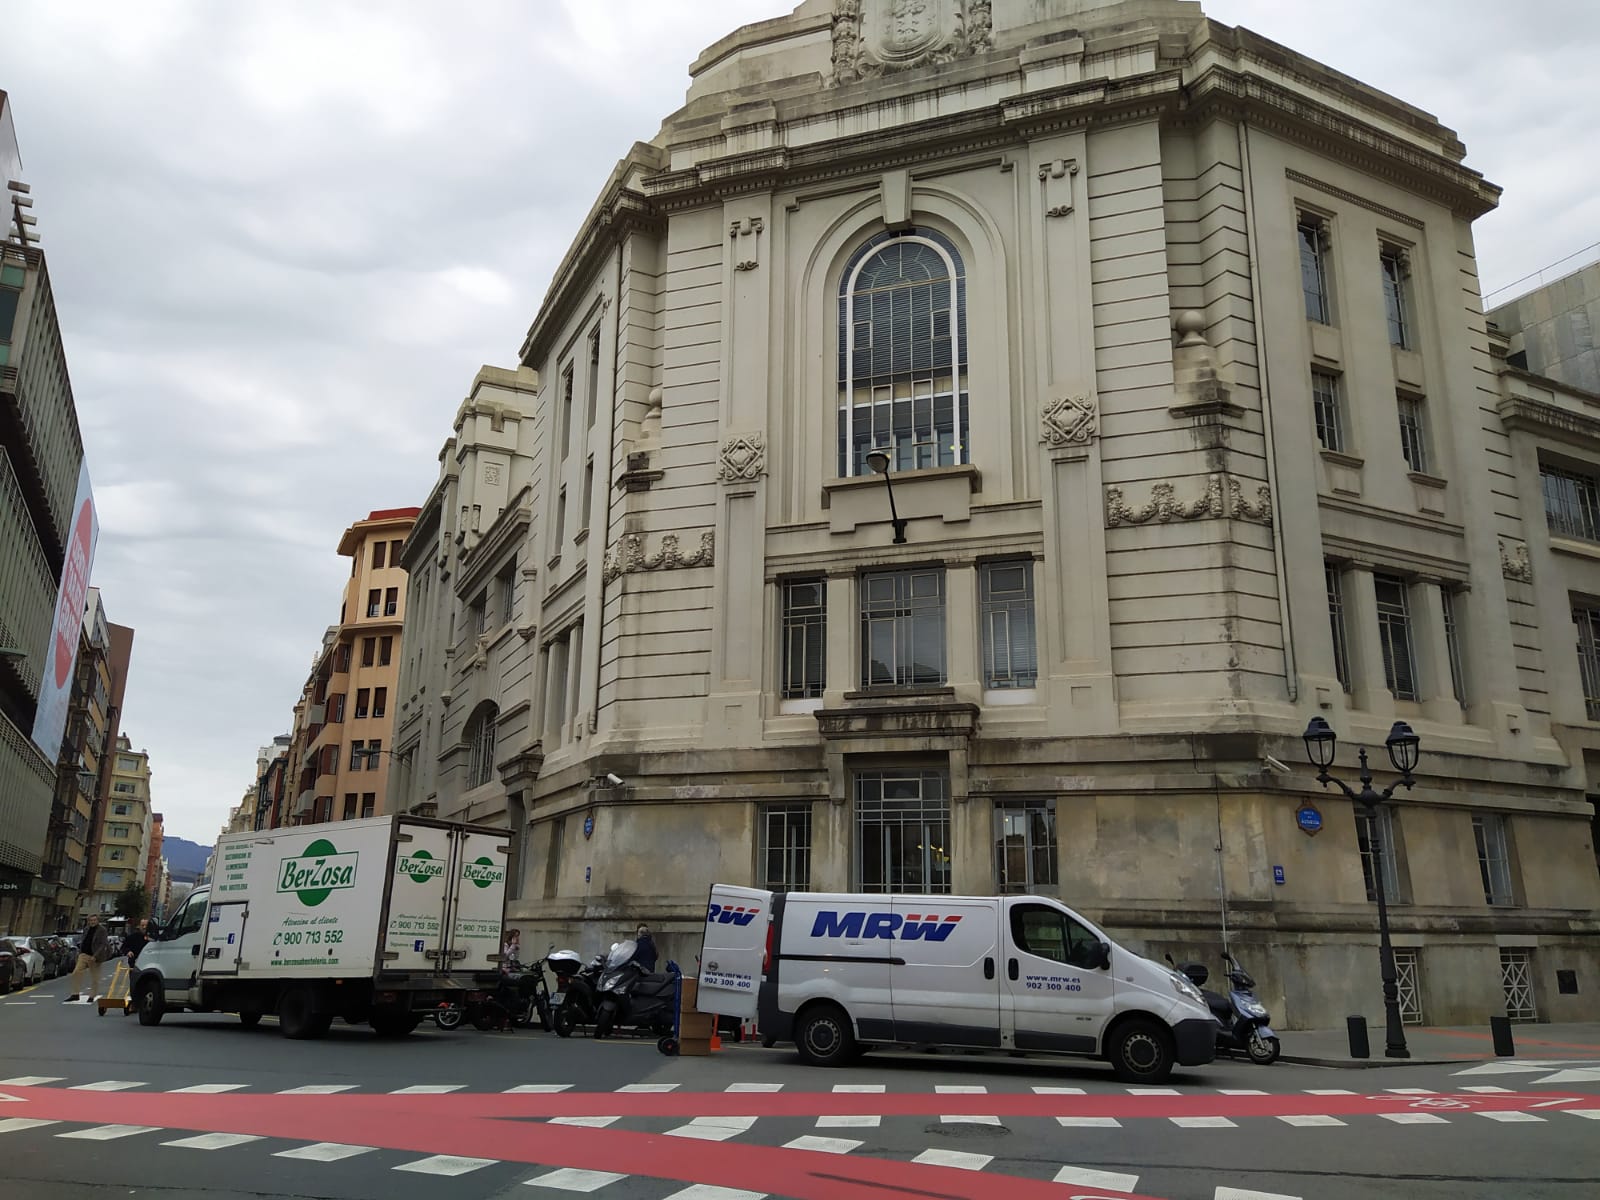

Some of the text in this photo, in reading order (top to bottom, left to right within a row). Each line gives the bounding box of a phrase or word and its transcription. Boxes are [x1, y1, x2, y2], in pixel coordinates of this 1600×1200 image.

[399, 858, 443, 875] BerZosa
[463, 864, 502, 881] BerZosa
[281, 858, 354, 890] BerZosa
[398, 920, 411, 929] 900
[414, 921, 425, 930] 713
[810, 910, 964, 942] MRW
[284, 929, 344, 945] 900 713 552
[704, 977, 718, 985] 902
[705, 971, 752, 981] www.mrw.es
[1026, 975, 1080, 983] www.mrw.es
[1065, 984, 1081, 992] 400
